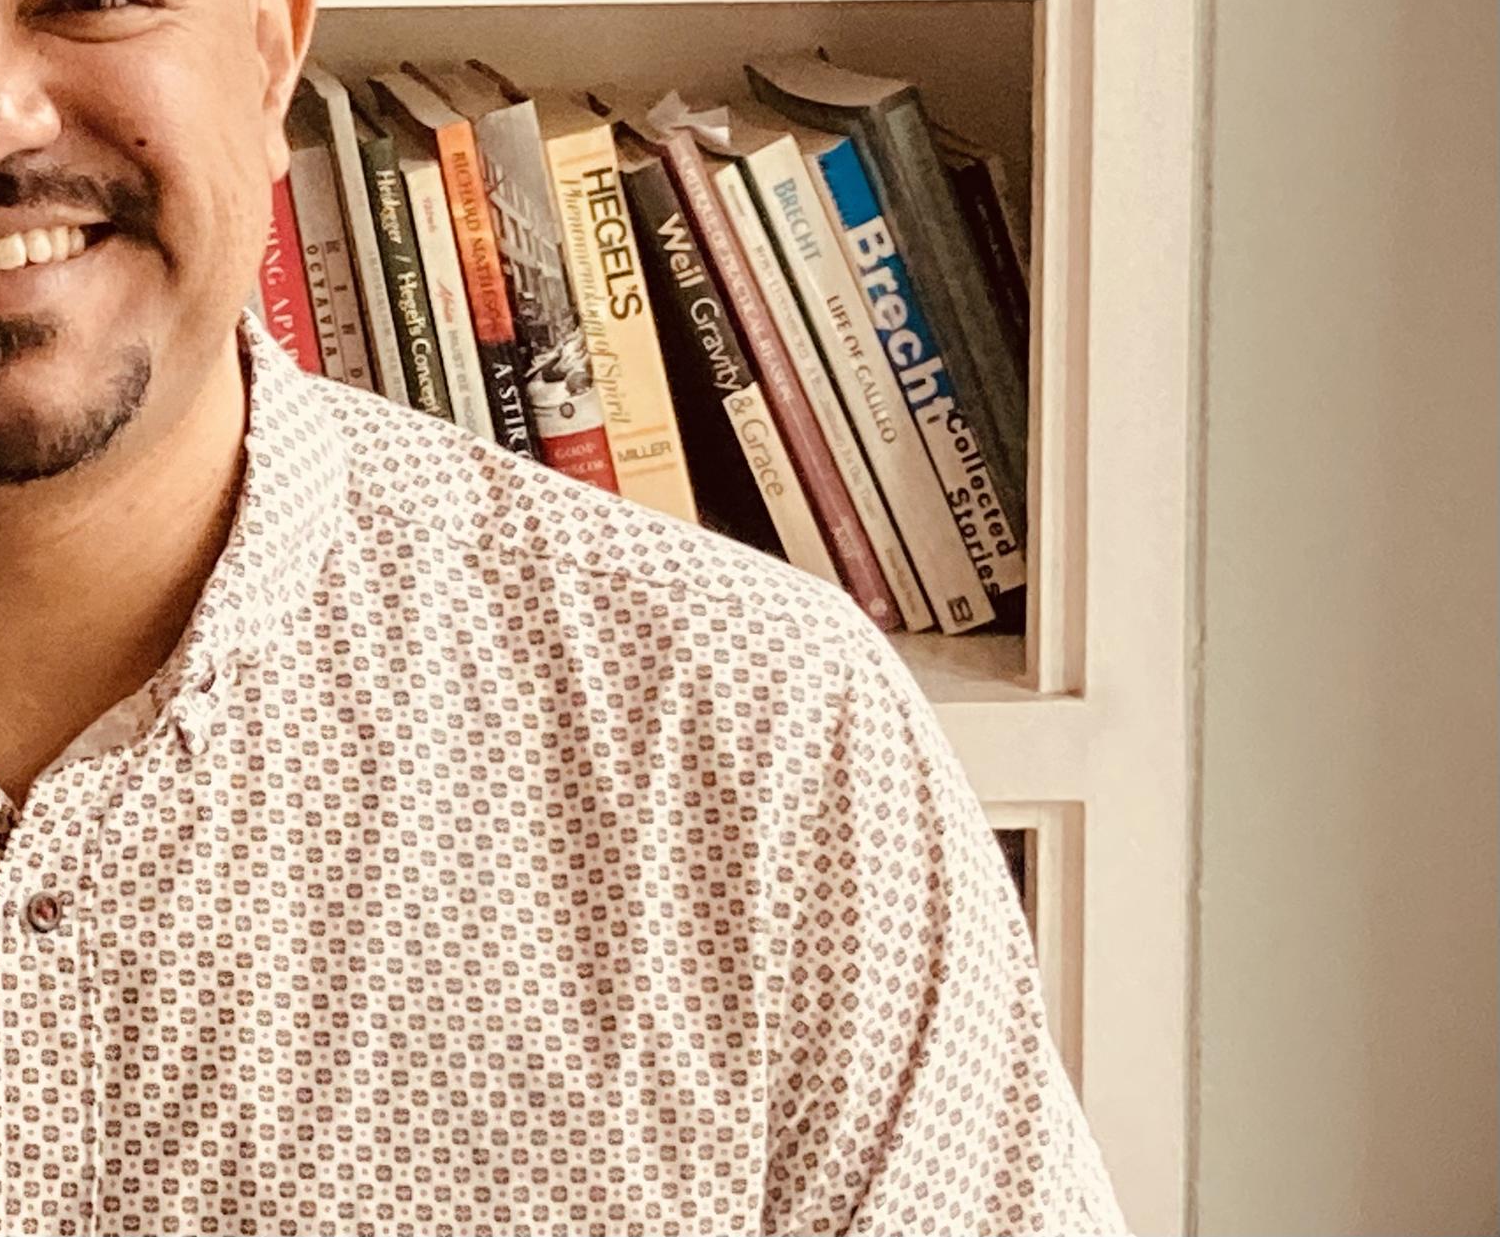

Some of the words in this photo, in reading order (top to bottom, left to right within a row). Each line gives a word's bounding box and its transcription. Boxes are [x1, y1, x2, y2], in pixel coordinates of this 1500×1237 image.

[376, 170, 405, 243] Heidegger
[452, 151, 483, 231] RICHARD
[560, 180, 609, 338] Phenomenology
[583, 167, 643, 321] HEGEL'S
[307, 244, 338, 357] OCTAVIA
[397, 271, 426, 336] Hegel's
[772, 177, 823, 263] BRECHT
[825, 293, 854, 333] LIFE
[842, 334, 866, 362] OF
[855, 364, 898, 445] GALILEO
[411, 337, 440, 414] Concept
[492, 363, 513, 378] A
[590, 340, 615, 362] of
[655, 213, 705, 288] Weil
[689, 297, 745, 392] Gravity
[730, 397, 754, 416] &
[744, 419, 787, 498] Grace
[762, 338, 793, 404] REASON
[846, 215, 956, 426] Brecht
[945, 413, 1017, 558] Collected
[497, 386, 523, 441] STIR
[596, 363, 632, 425] Spirit
[617, 441, 672, 463] MILLER
[946, 487, 1003, 597] Stories
